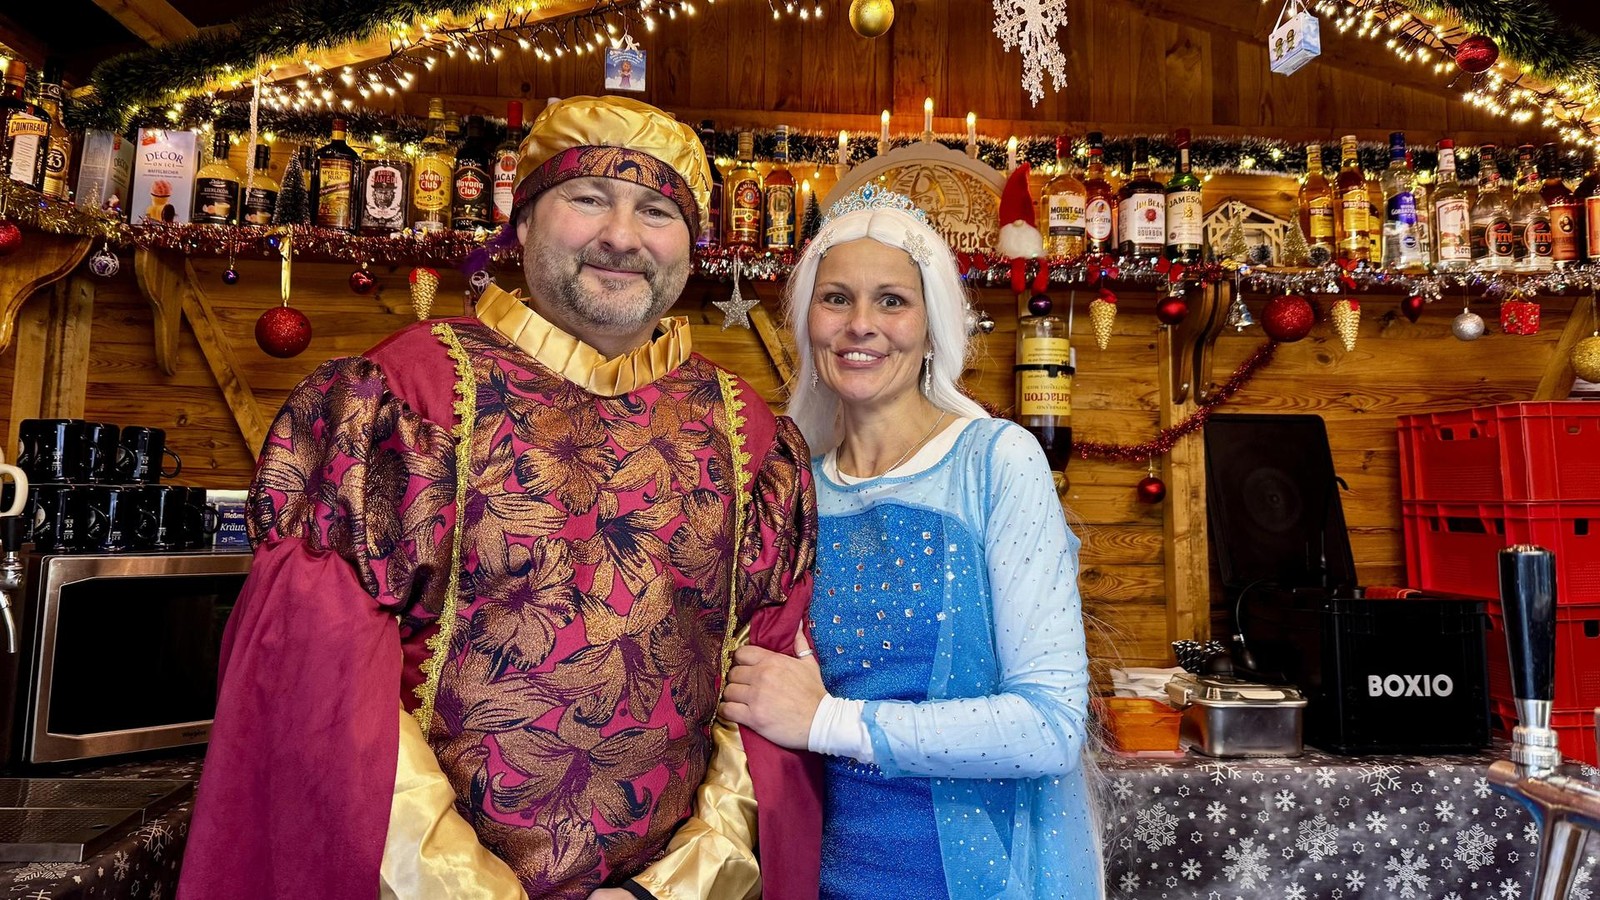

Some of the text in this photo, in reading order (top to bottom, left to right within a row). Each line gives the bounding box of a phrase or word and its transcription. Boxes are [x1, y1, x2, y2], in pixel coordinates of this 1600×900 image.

[11, 120, 45, 132] COINTREAU
[145, 150, 184, 164] DECOR
[420, 180, 438, 189] Club
[456, 179, 484, 189] Havana
[459, 186, 478, 195] Club
[464, 204, 471, 213] 7
[1134, 198, 1164, 212] JIM BEAM
[1050, 206, 1073, 214] MOUNT
[1138, 229, 1162, 237] BOURBON
[1368, 673, 1454, 697] BOXIO
